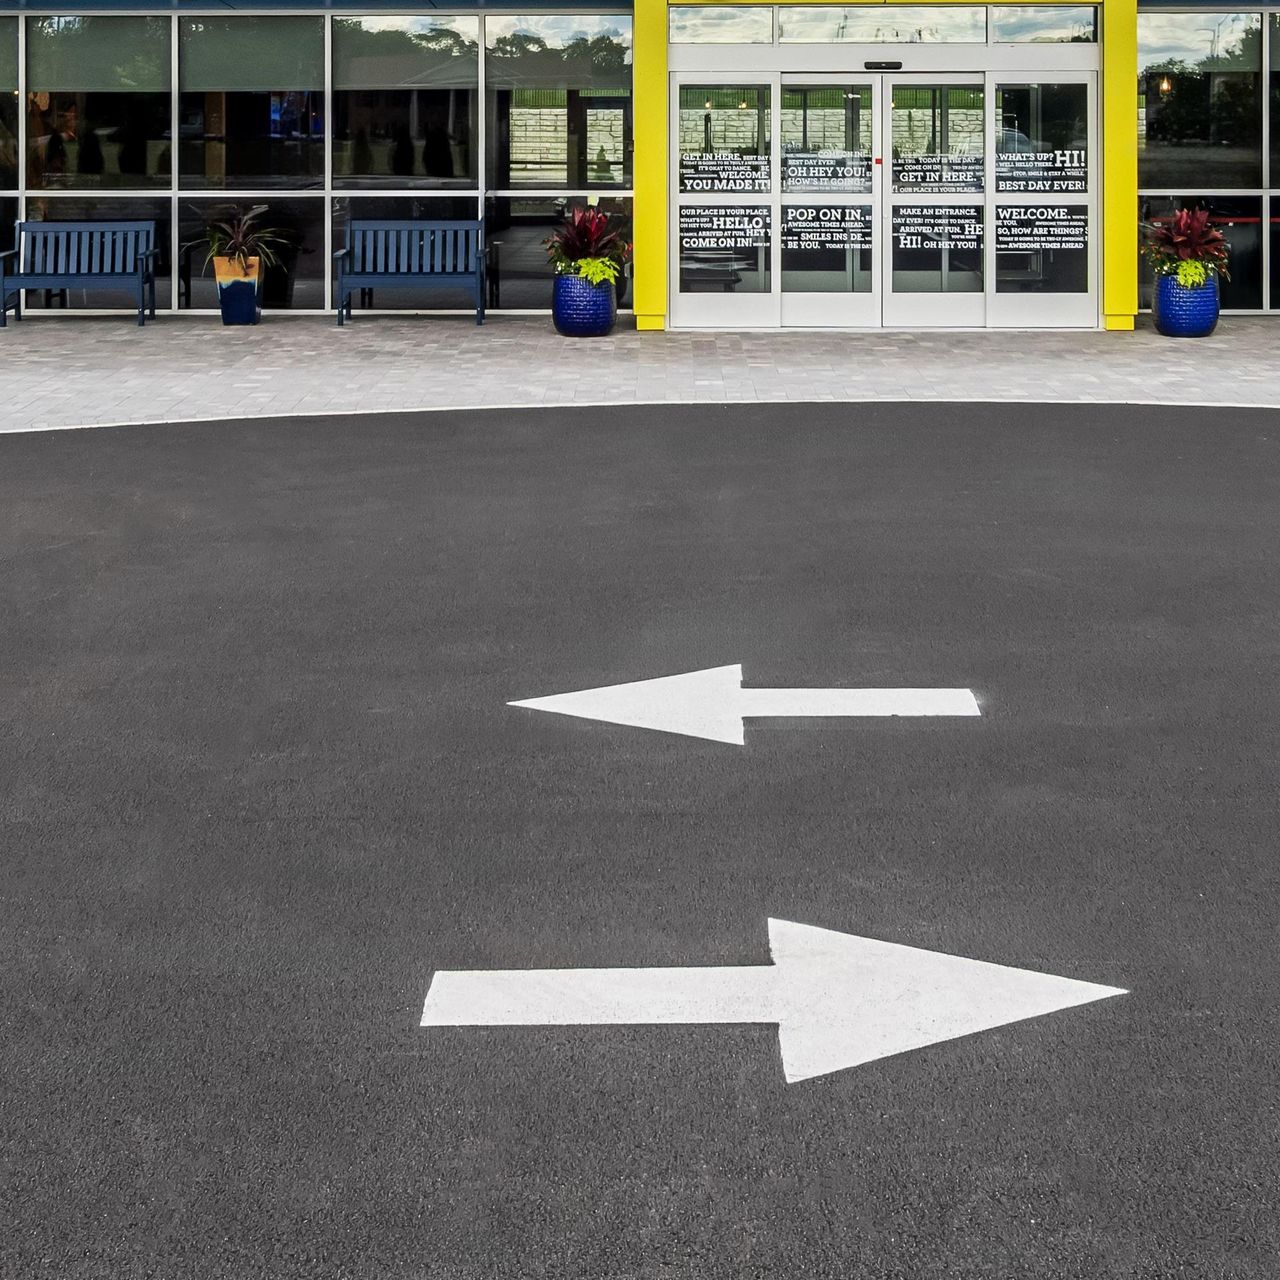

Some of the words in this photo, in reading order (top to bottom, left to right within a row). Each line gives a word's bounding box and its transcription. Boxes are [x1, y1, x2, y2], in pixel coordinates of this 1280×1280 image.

[1055, 150, 1085, 167] HI!
[788, 167, 808, 177] OH
[810, 167, 834, 177] HEY
[836, 167, 865, 177] YOU!
[900, 172, 923, 181] GET
[926, 172, 940, 181] IN
[942, 172, 976, 181] HERE.
[684, 180, 711, 190] YOU
[714, 180, 752, 190] MADE
[755, 180, 770, 190] IT!
[999, 181, 1026, 190] BEST
[1028, 181, 1051, 190] DAY
[1054, 181, 1085, 190] EVER!
[787, 209, 816, 220] POP
[820, 209, 841, 220] ON
[845, 209, 864, 220] IN.
[998, 208, 1071, 219] WELCOME.
[713, 217, 763, 229] HELLO
[683, 238, 717, 247] COME
[719, 238, 735, 247] ON
[737, 238, 752, 247] IN!
[899, 236, 921, 248] HI!
